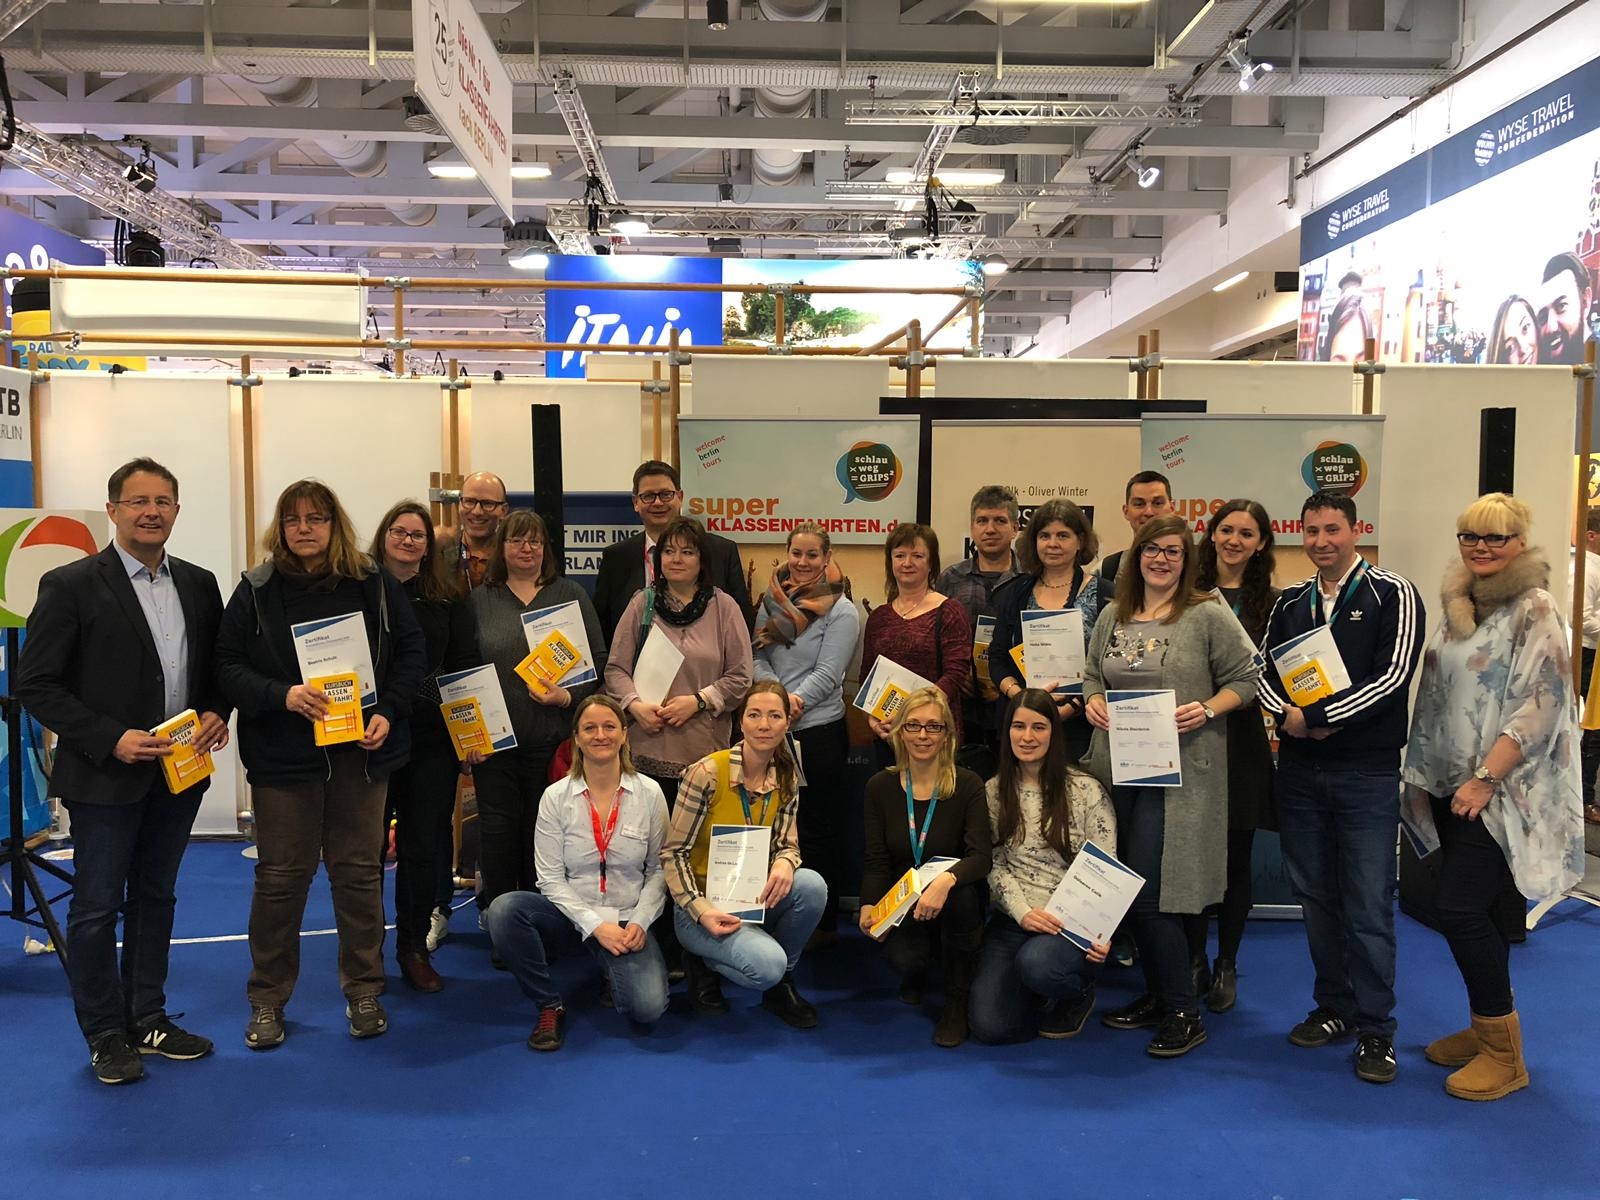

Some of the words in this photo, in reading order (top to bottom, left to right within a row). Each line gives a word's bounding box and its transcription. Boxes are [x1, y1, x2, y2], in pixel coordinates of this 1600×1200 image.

[435, 12, 447, 65] 25
[1498, 114, 1529, 143] WYSE
[1531, 93, 1574, 126] TRAVEL
[1497, 110, 1574, 154] CONFEDERATION
[1342, 202, 1362, 222] WYSE
[1363, 189, 1389, 212] TRAVEL
[695, 435, 726, 453] welcome
[1158, 435, 1190, 453] welcome
[698, 448, 720, 461] berlin
[855, 455, 888, 464] schlau
[1161, 448, 1183, 461] berlin
[1320, 455, 1353, 464] schlau
[702, 457, 722, 469] tours
[858, 465, 879, 473] weg
[1166, 457, 1185, 469] tours
[1323, 465, 1344, 473] weg
[1028, 486, 1056, 497] Oliver
[1058, 486, 1089, 497] Winter
[688, 496, 780, 520] super
[573, 530, 606, 543] MIR
[334, 695, 353, 704] FAHRT
